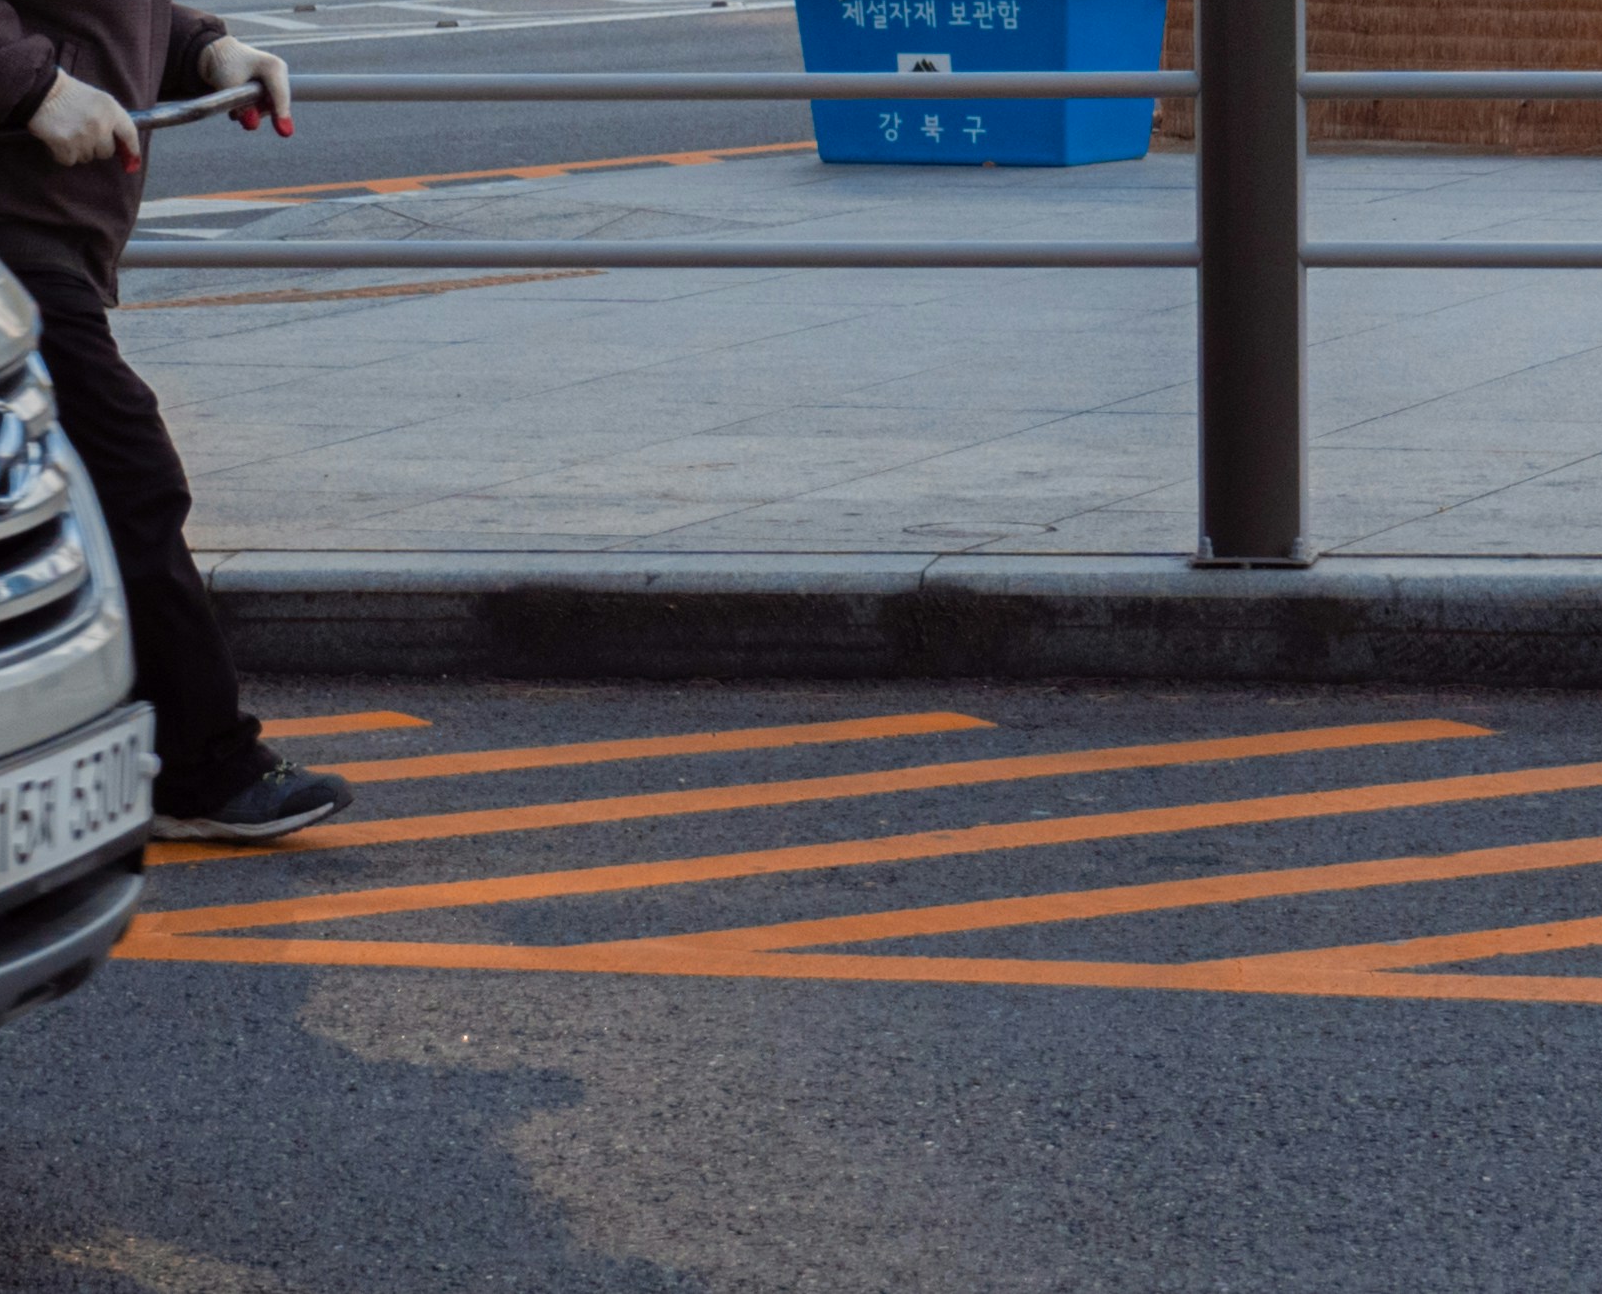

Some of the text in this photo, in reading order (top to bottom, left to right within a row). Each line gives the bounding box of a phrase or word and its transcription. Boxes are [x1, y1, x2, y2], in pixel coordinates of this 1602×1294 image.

[841, 0, 1021, 30] 제설자재 보관함
[878, 112, 987, 144] 강북구
